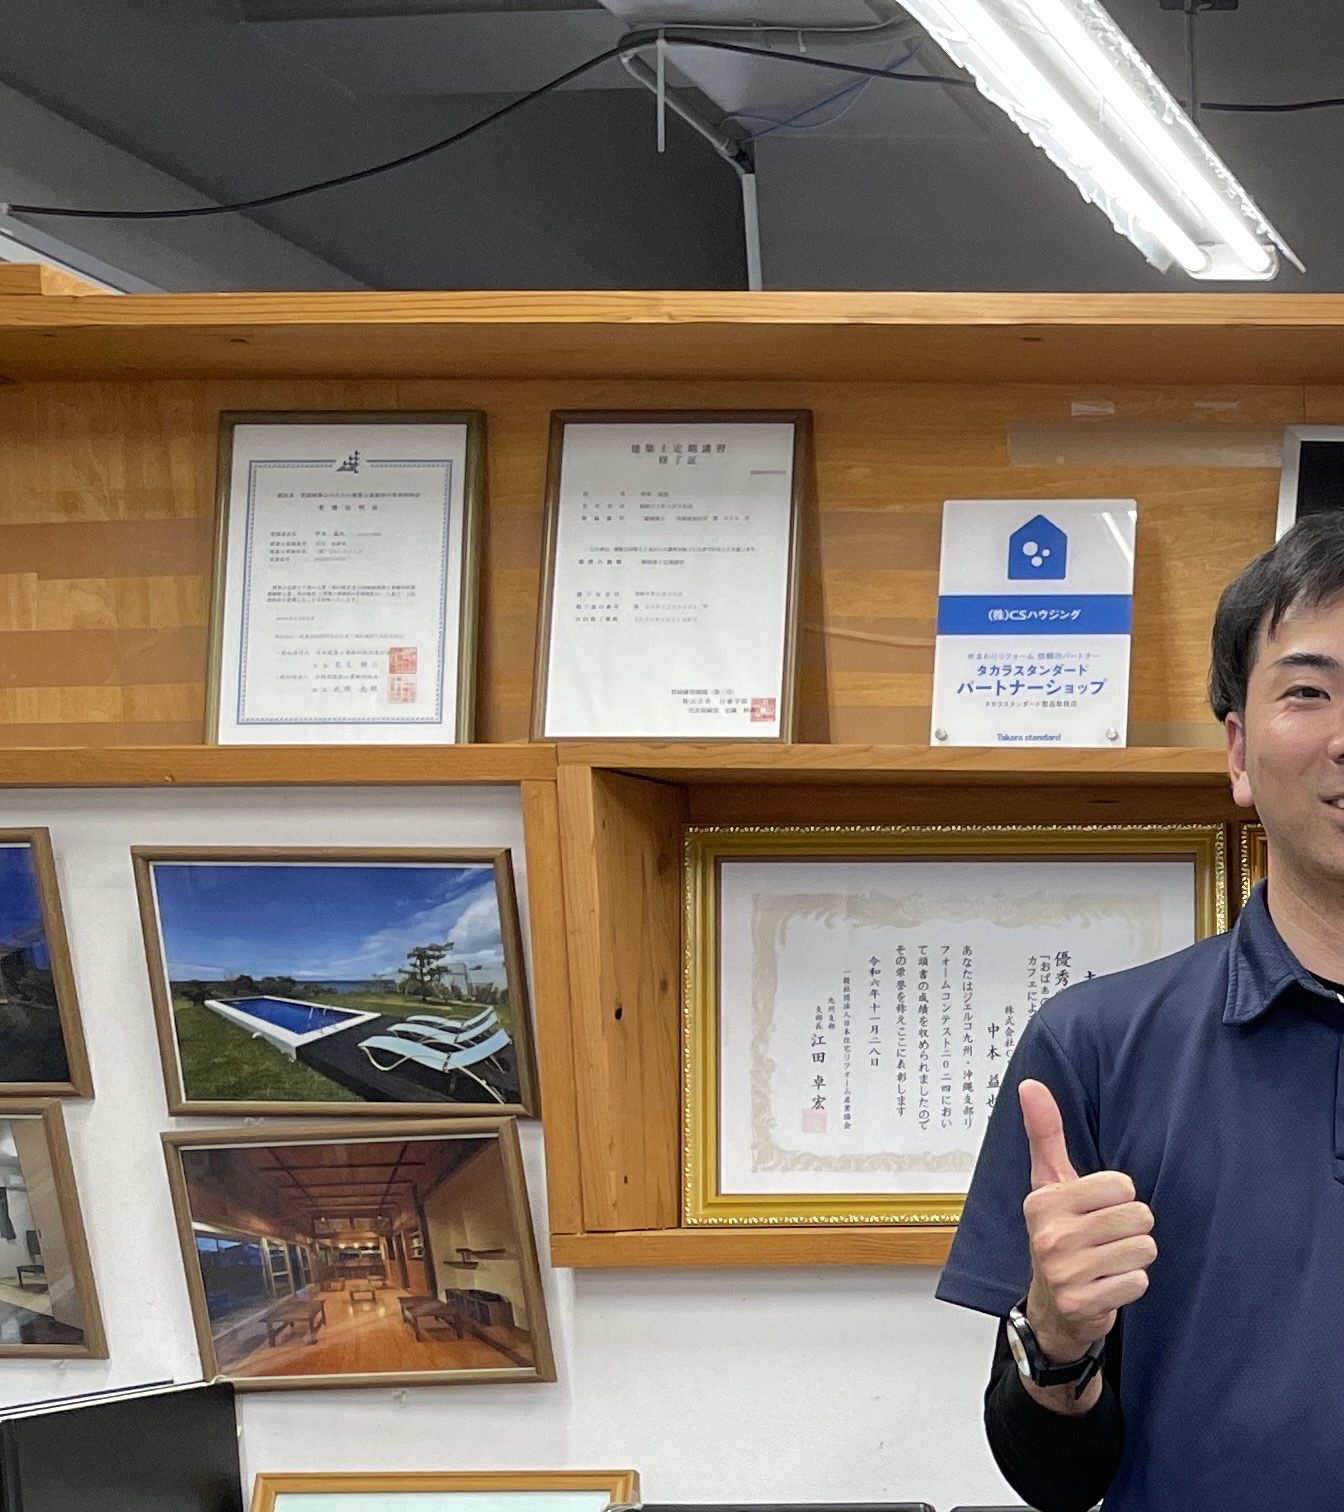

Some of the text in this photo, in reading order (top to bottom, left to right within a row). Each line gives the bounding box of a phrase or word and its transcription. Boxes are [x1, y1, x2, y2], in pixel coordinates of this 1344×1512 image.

[977, 664, 1089, 677] タカラスタンダード
[957, 678, 1108, 696] パートナーショップ
[997, 733, 1062, 741] Takara standard
[1054, 951, 1072, 993] 優秀
[868, 956, 881, 1067] 令和六年十一月二八日
[918, 945, 930, 1130] て頭書の成績を収められましたので
